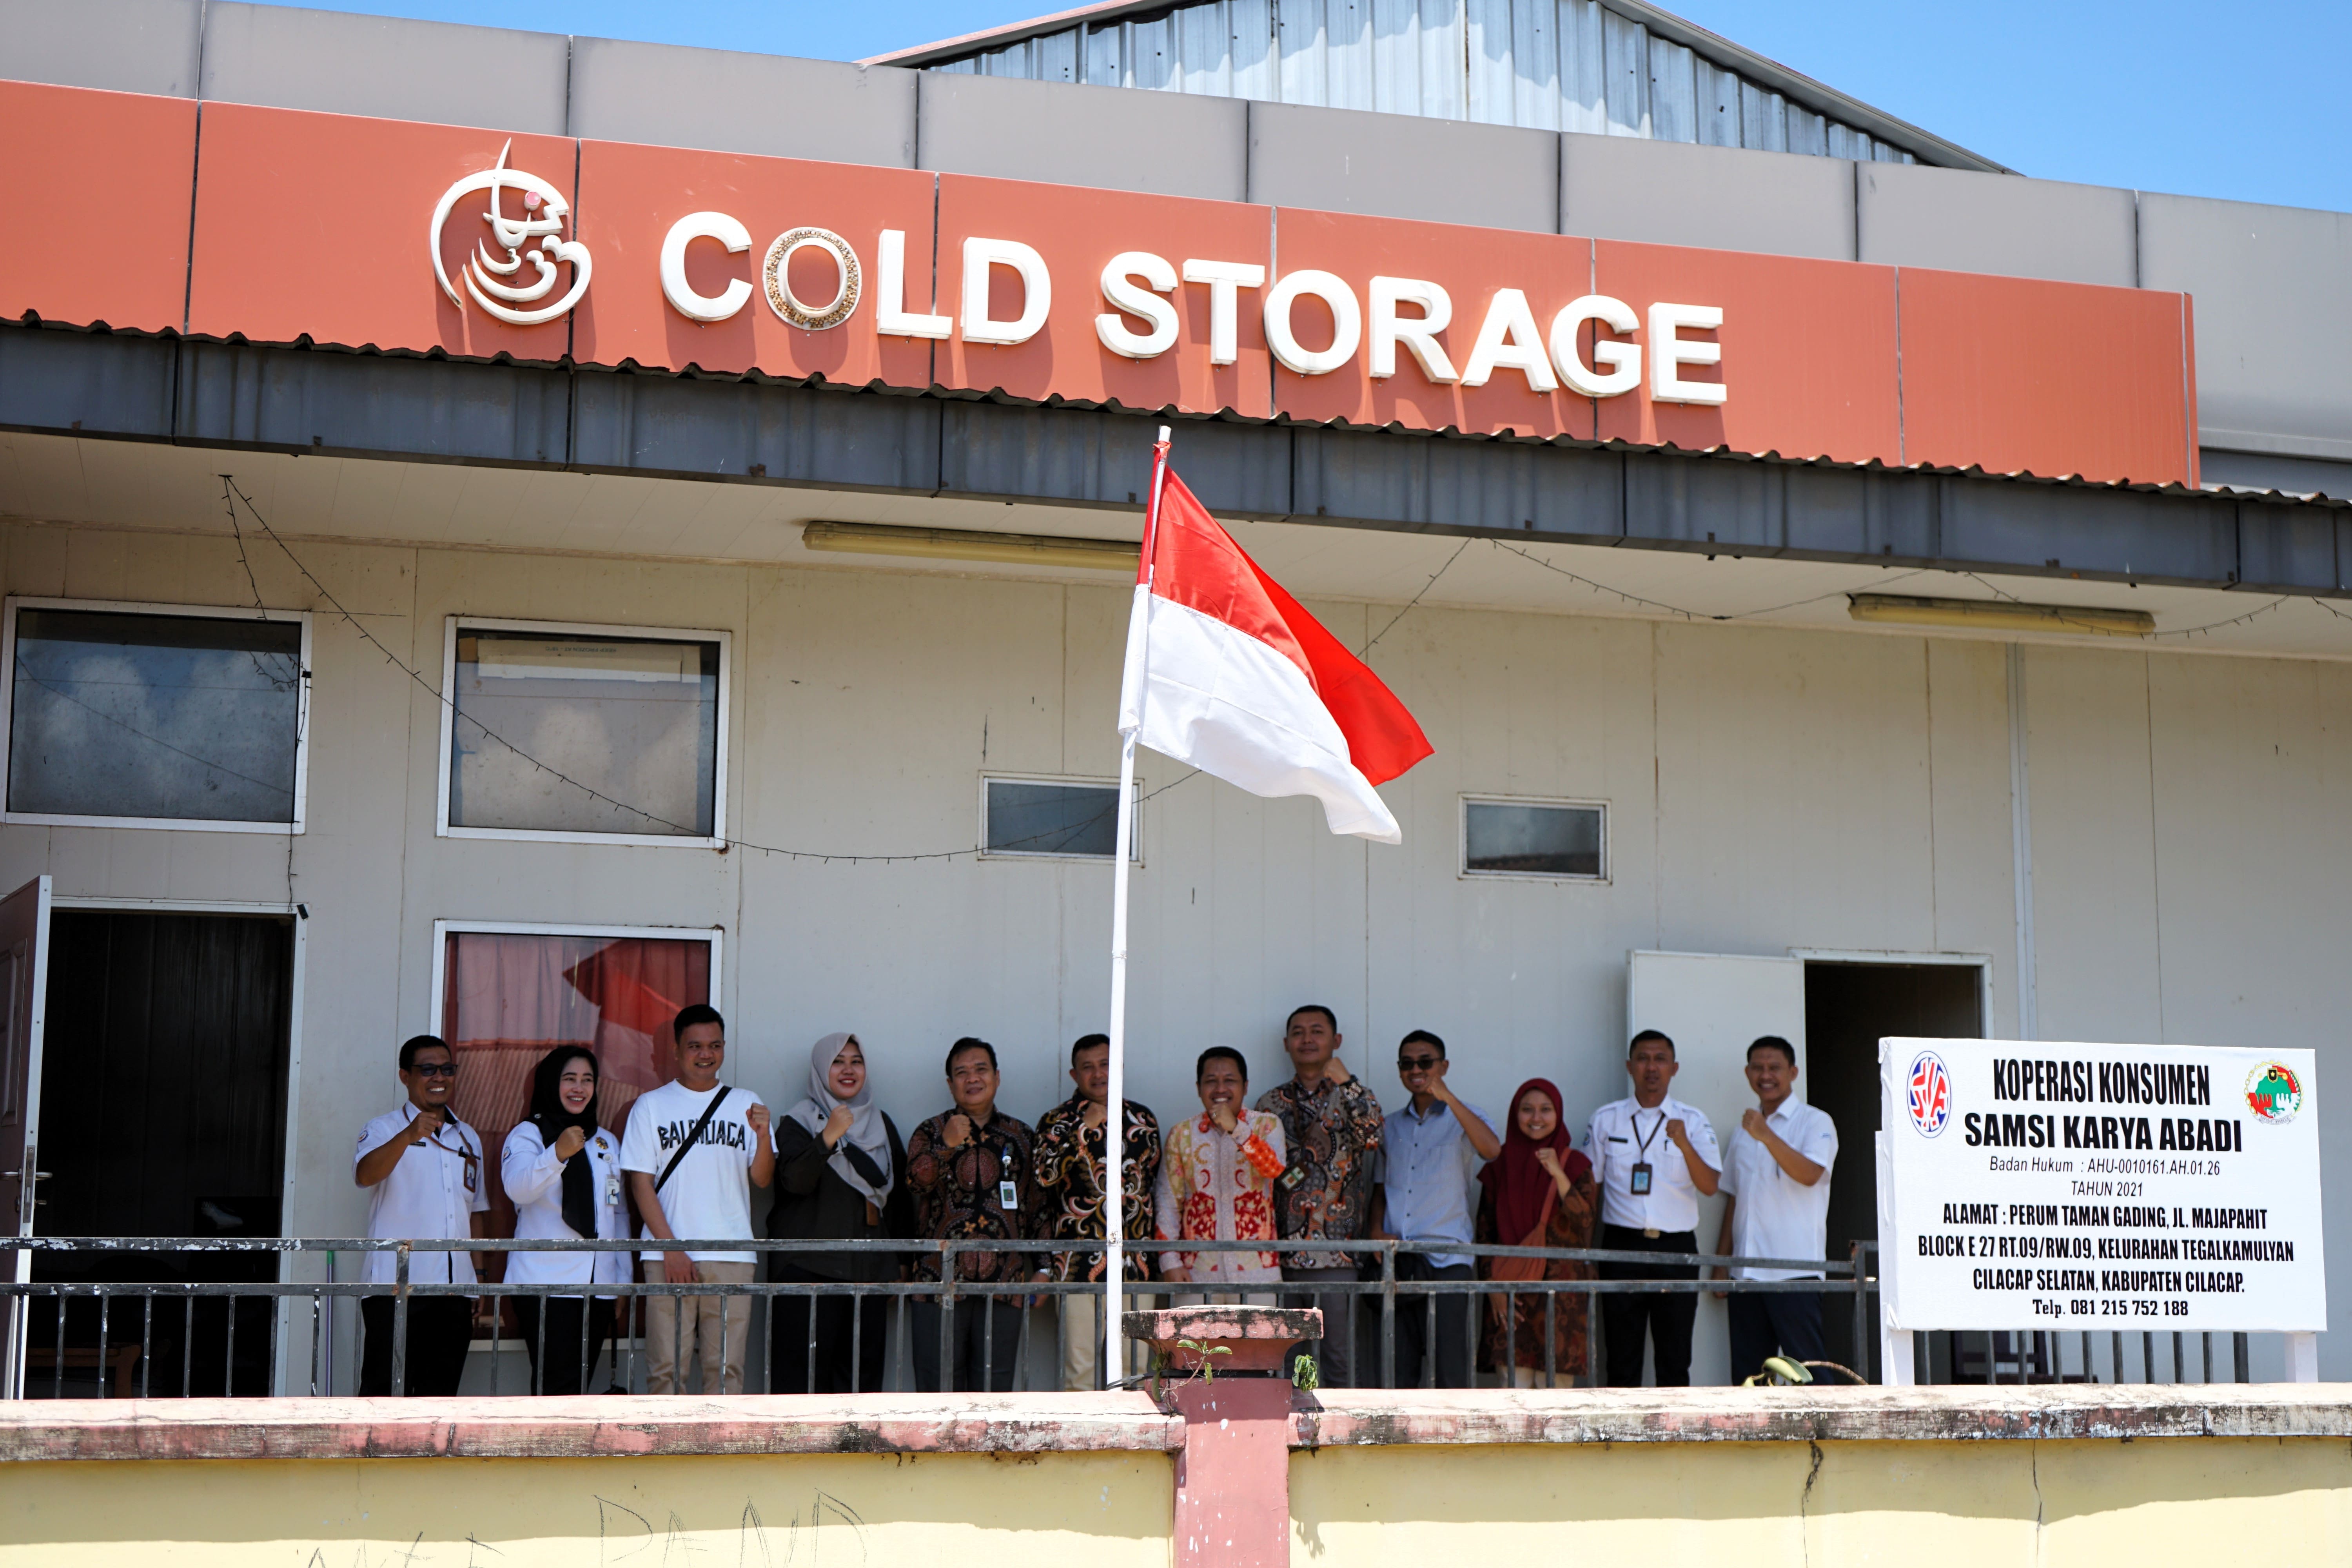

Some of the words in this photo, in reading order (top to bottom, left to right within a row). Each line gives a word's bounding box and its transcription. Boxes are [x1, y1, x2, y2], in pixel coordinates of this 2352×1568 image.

[660, 211, 1052, 345] COLD
[1094, 251, 1727, 406] STORAGE
[1993, 1059, 2093, 1103] KOPERASI
[2099, 1062, 2210, 1105] KONSUMEN
[1965, 1112, 2055, 1148] SAMSI
[2063, 1116, 2153, 1150] KARYA
[2159, 1118, 2242, 1152] ABADI
[1990, 1156, 2027, 1171] Badan
[2032, 1157, 2073, 1172] Hukum
[2087, 1158, 2220, 1175] AHU-0010161.AH.01.26
[2071, 1181, 2112, 1196] TAHUN
[2117, 1182, 2142, 1196] 2021
[1943, 1203, 1998, 1225] ALAMAT
[2010, 1205, 2058, 1226] PERUM
[2061, 1205, 2109, 1227] TAMAN
[2113, 1206, 2169, 1230] GADING,
[2172, 1207, 2189, 1228] JL.
[2192, 1208, 2267, 1229] MAJAPAHIT
[1918, 1235, 1965, 1257] BLOCK
[1969, 1236, 1976, 1257] E
[1979, 1236, 1995, 1257] 27
[1999, 1237, 2095, 1260] RT.09/RW.09,
[2098, 1238, 2178, 1259] KELURAHAN
[2181, 1240, 2294, 1261] TEGALKAMULYAN
[1973, 1269, 2033, 1290] CILACAP
[2037, 1269, 2098, 1293] SELATAN,
[2102, 1270, 2181, 1292] KABUPATEN
[2185, 1271, 2245, 1292] CILACAP.
[2033, 1299, 2066, 1318] Telp.
[2071, 1299, 2095, 1315] 081
[2102, 1300, 2127, 1315] 215
[2132, 1300, 2158, 1316] 752
[2163, 1301, 2188, 1316] 188
